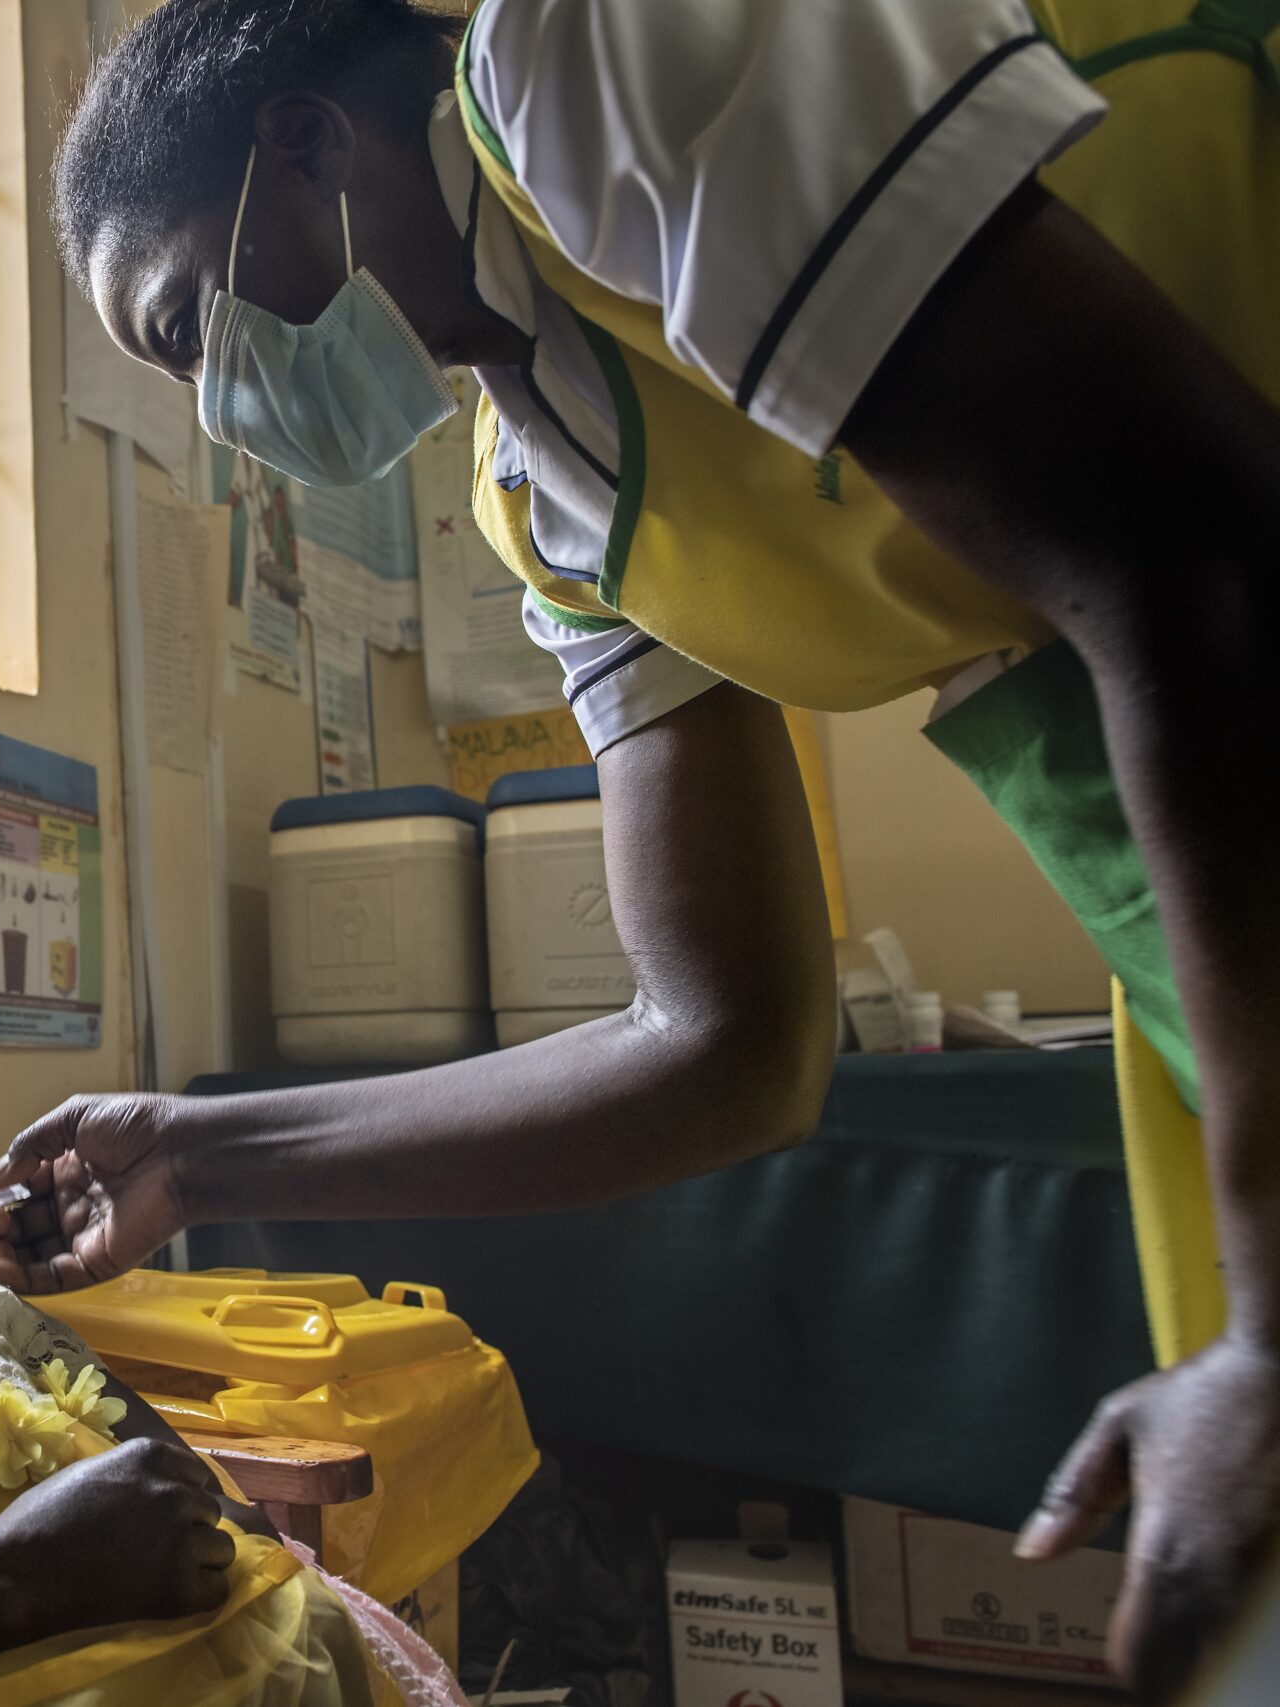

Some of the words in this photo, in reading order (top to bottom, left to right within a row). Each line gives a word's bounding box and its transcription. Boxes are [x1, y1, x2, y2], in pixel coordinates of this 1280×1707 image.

[774, 1597, 801, 1617] 5L
[686, 1625, 761, 1657] Safety
[772, 1633, 818, 1658] Box
